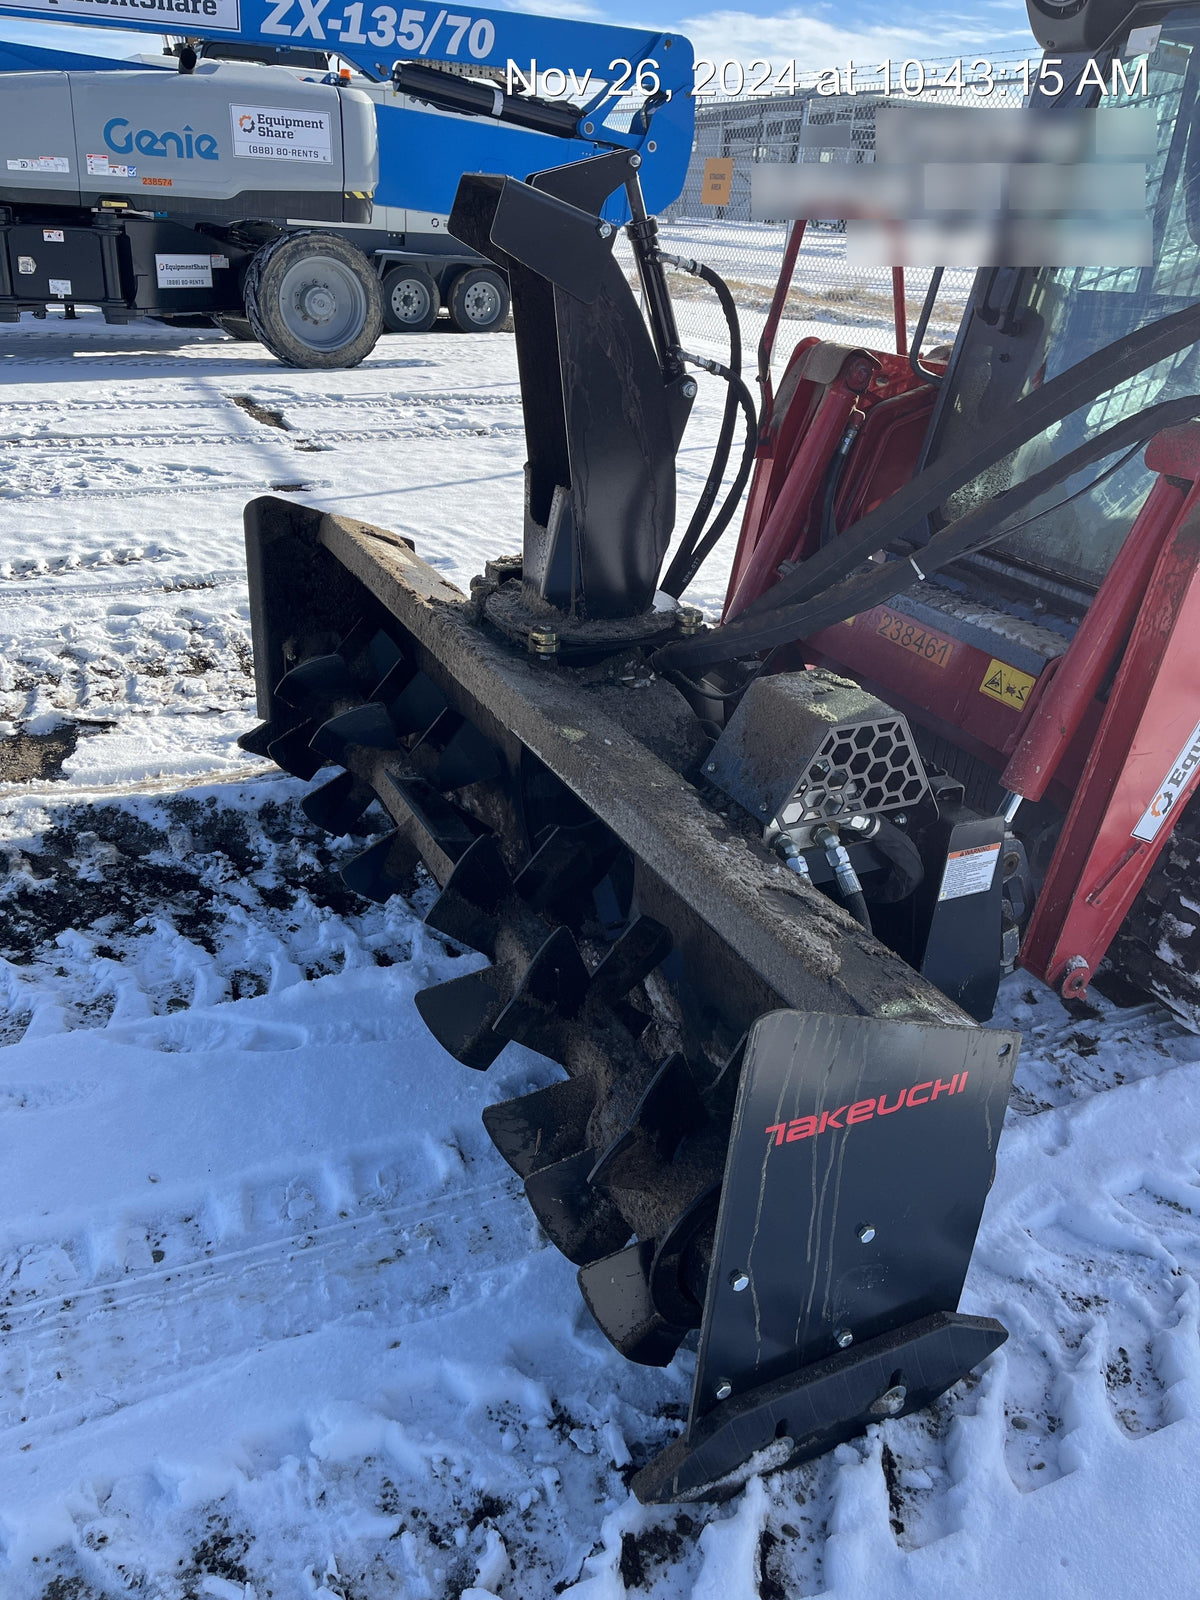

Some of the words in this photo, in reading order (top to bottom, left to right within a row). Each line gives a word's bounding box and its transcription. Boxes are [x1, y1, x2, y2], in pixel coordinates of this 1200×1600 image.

[260, 0, 496, 60] ZX-135/70
[257, 114, 324, 130] Equipment
[103, 117, 219, 160] Genie
[258, 127, 294, 139] Share
[248, 145, 274, 155] (888)
[276, 148, 319, 158] 80-RENTS
[165, 263, 209, 271] EquipmentShare
[877, 614, 949, 666] 238461
[964, 845, 991, 856] WARNING
